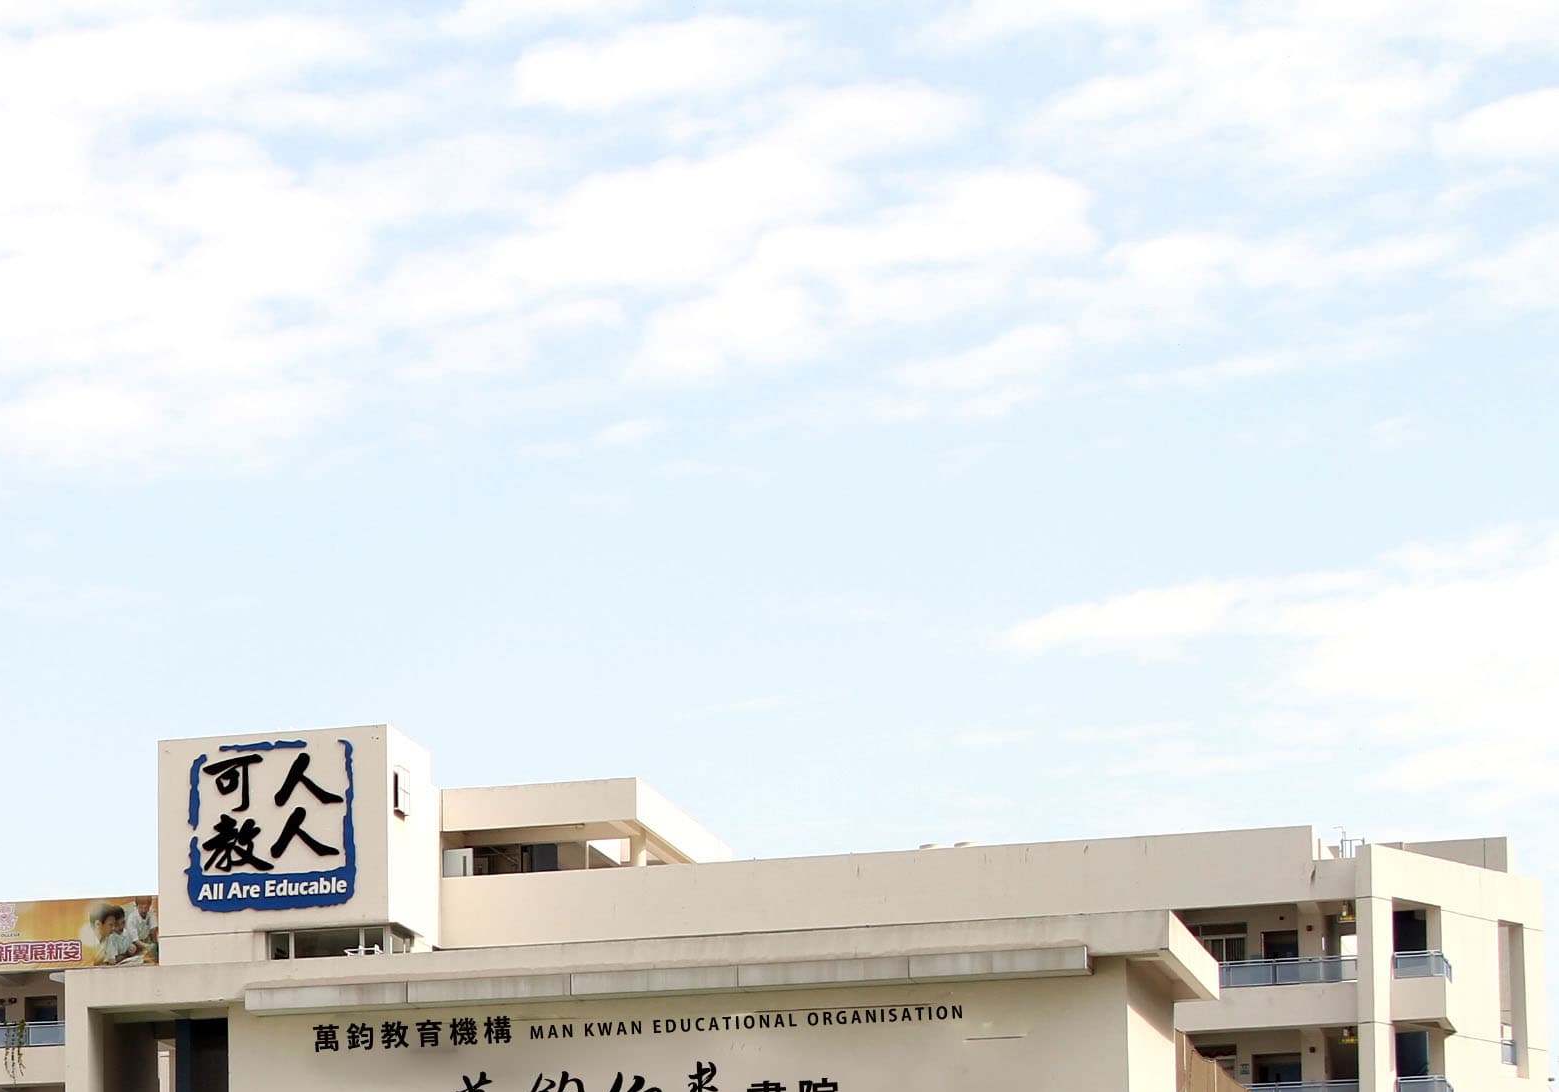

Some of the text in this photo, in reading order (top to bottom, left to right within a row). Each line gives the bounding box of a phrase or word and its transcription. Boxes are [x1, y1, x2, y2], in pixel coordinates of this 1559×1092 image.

[197, 877, 348, 901] All Are Educable
[313, 1015, 513, 1051] 萬鈞教育機構
[530, 1005, 964, 1039] MAN KWAN EDUCATIONAL ORGANISATION
